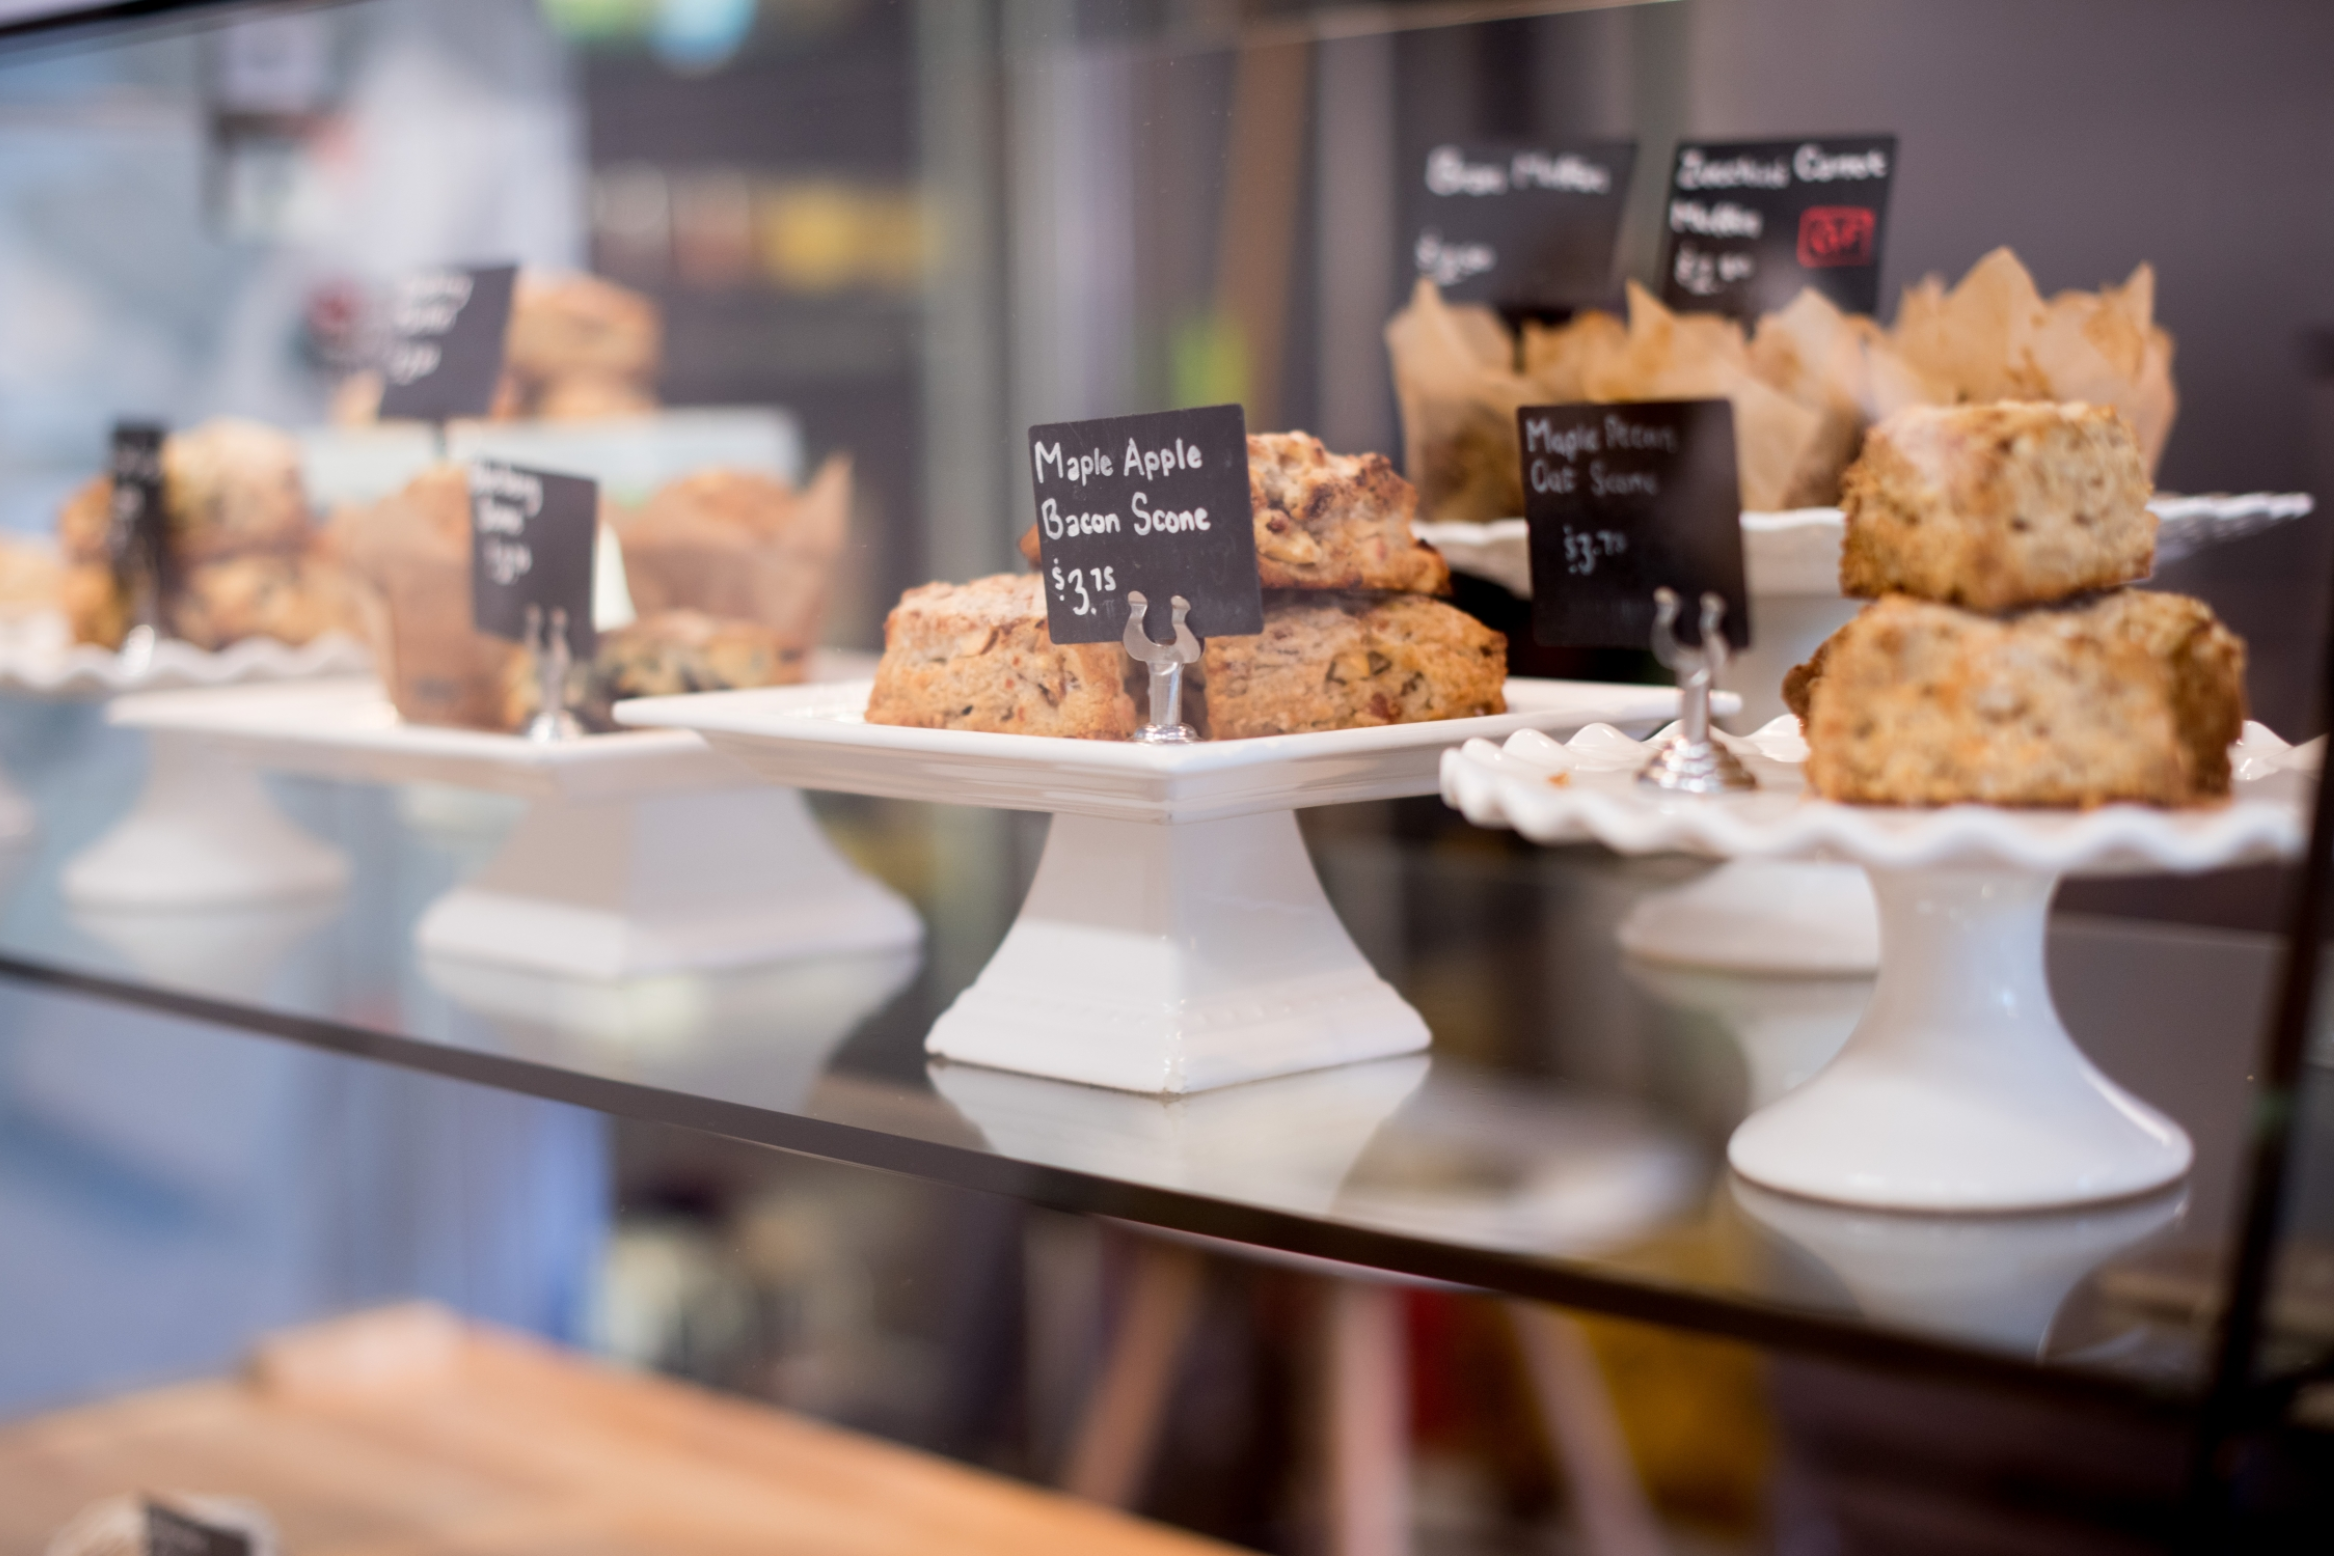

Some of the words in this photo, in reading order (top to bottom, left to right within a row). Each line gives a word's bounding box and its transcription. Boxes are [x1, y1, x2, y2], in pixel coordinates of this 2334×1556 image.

[1034, 440, 1114, 486] Maple
[1123, 437, 1203, 481] Apple
[1525, 417, 1599, 463] Maple
[1604, 414, 1676, 452] Pecan
[1530, 458, 1577, 494] Oat
[1590, 460, 1658, 497] Scone
[1041, 498, 1121, 540] Bacon
[1131, 491, 1211, 536] Scone
[1052, 557, 1116, 616] $3.75
